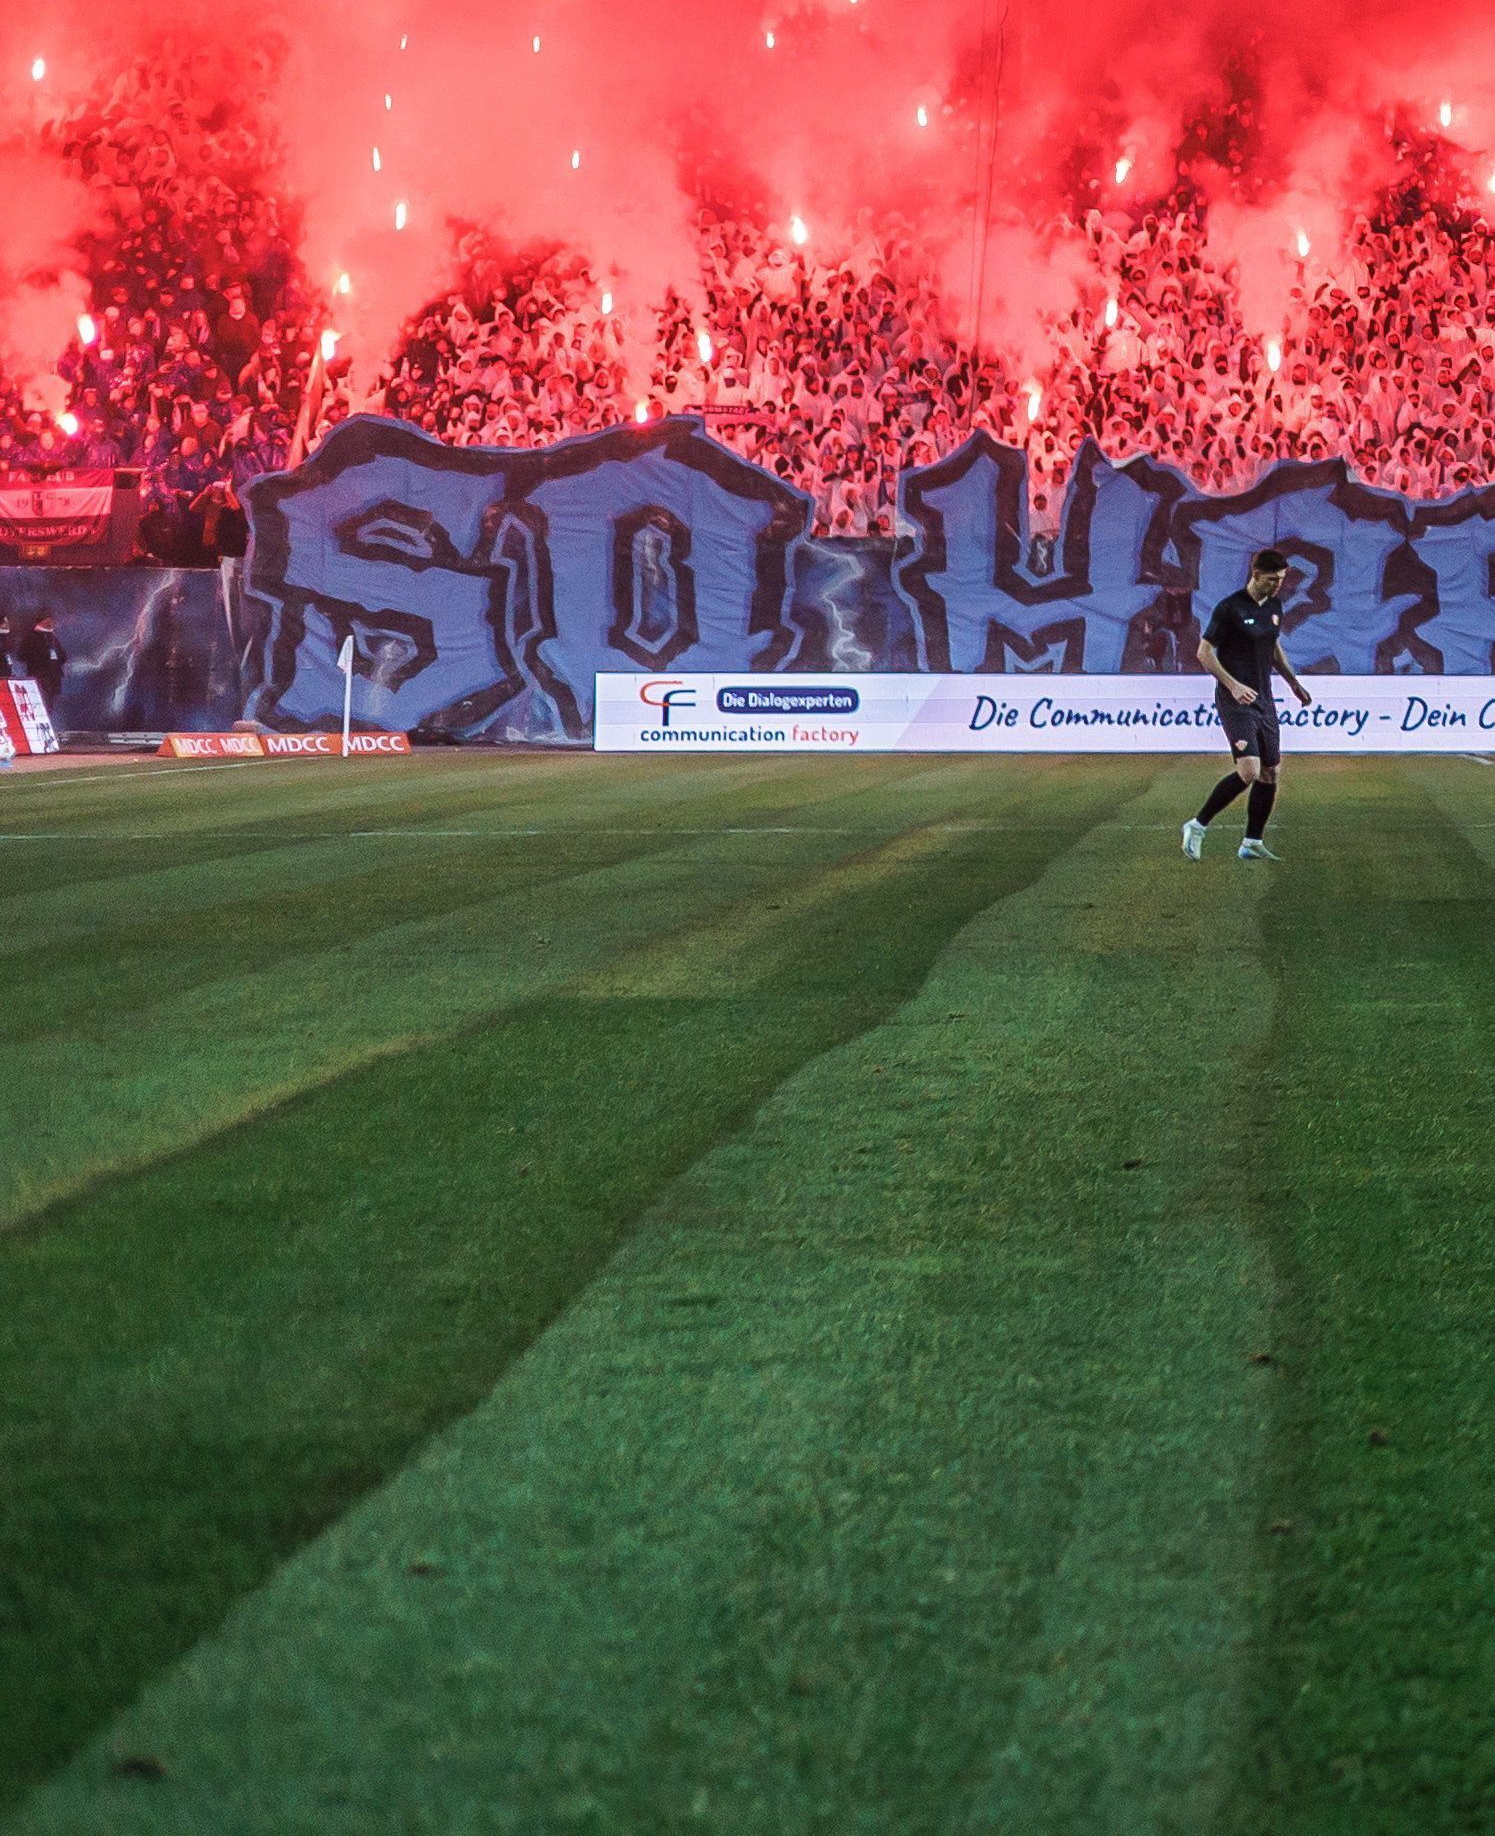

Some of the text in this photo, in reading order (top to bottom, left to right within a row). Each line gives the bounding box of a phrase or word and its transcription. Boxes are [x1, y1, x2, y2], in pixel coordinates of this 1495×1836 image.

[240, 414, 816, 746] SO
[722, 692, 852, 711] Die Dialogexperten
[968, 694, 1017, 731] Die
[1029, 696, 1222, 730] Communicatio
[1274, 697, 1370, 737] actory
[1400, 695, 1466, 732] Dein
[220, 735, 263, 754] MDCC
[266, 735, 330, 754] MDCC
[345, 735, 405, 753] MDCC
[640, 724, 859, 746] communication factory
[174, 736, 218, 755] MDCC
